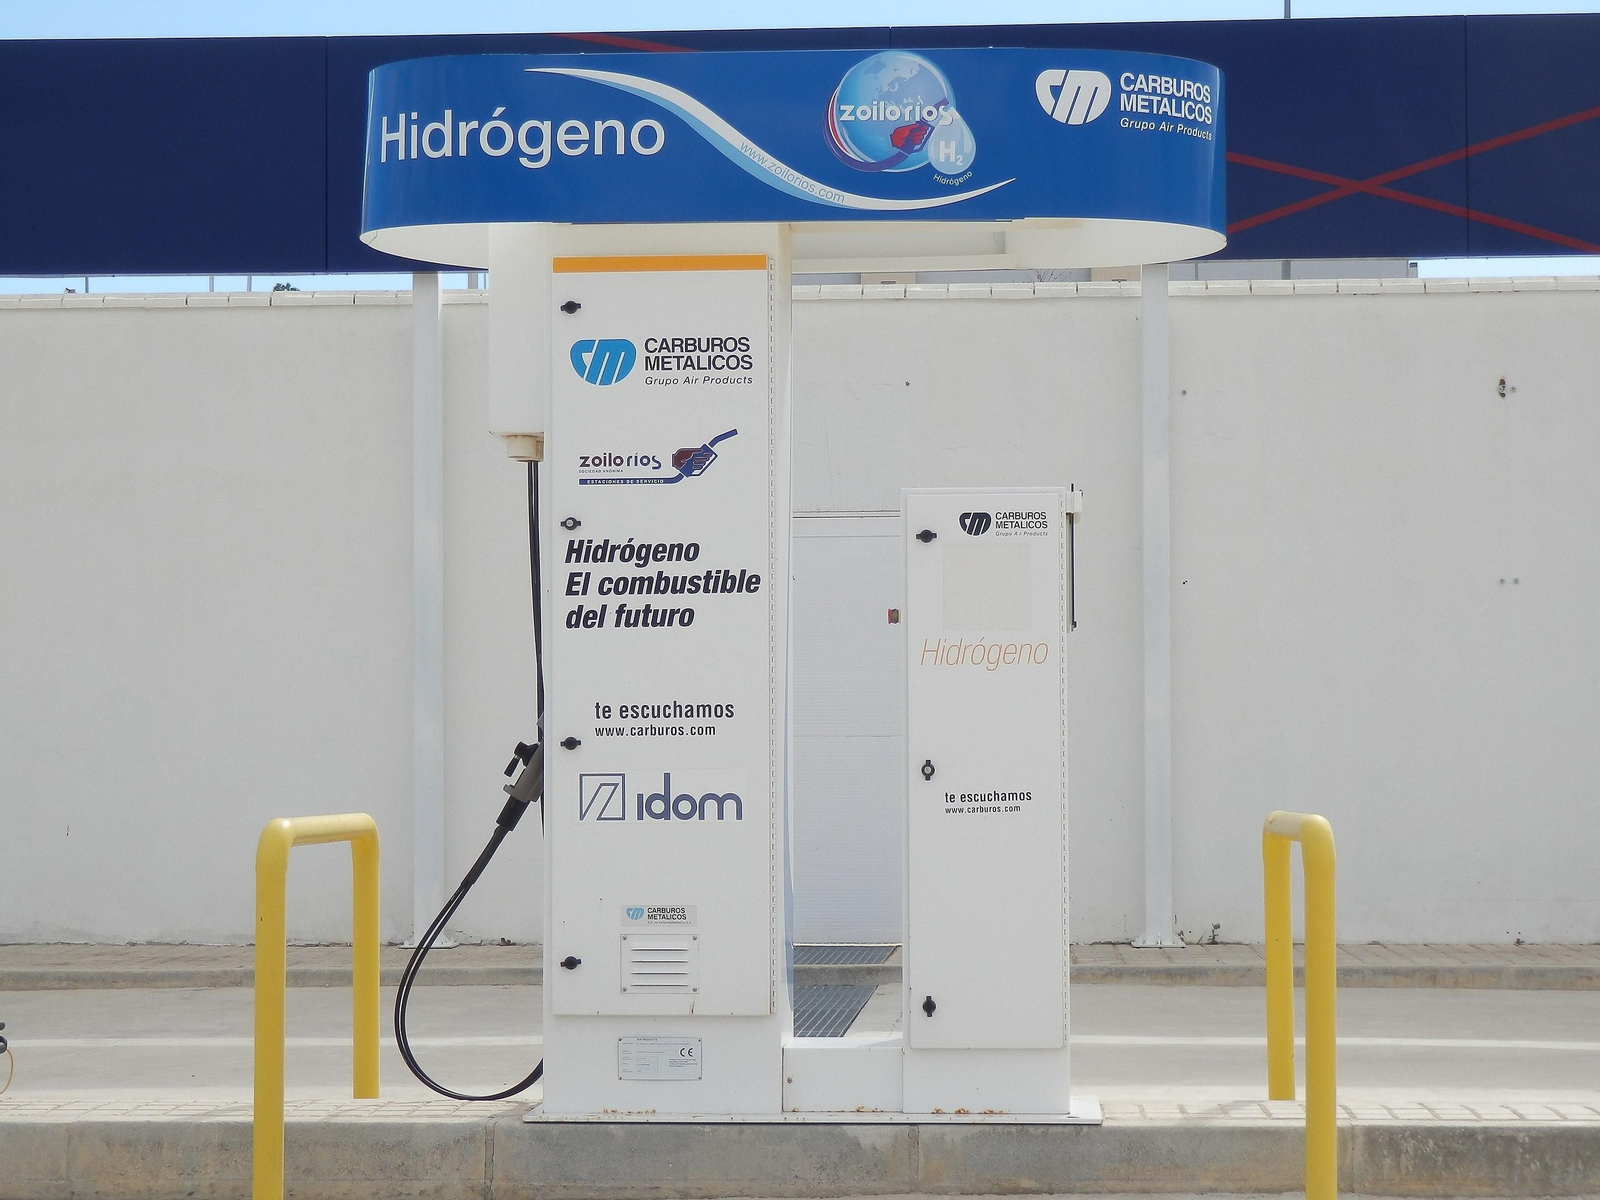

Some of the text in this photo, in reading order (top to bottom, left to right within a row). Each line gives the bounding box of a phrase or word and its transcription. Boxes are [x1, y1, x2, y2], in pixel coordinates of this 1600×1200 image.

[1120, 72, 1211, 104] CARBUROS
[1120, 93, 1212, 125] METALICOS
[380, 107, 665, 169] Hidrógeno
[1120, 117, 1213, 141] Grupo Air Products
[740, 142, 845, 204] www.zoilorios.com
[933, 170, 973, 186] Hidrógeno
[644, 336, 751, 354] CARBUROS
[644, 354, 754, 371] METALICOS
[644, 375, 753, 387] Grupo Air Products
[995, 511, 1047, 520] CARBUROS
[995, 520, 1049, 529] METALICOS
[565, 538, 700, 568] Hidrógeno
[565, 569, 761, 596] El combustible
[565, 603, 695, 629] del futuro
[920, 636, 1049, 672] Hidrógeno
[594, 701, 735, 719] te escuchamos
[594, 724, 717, 737] www.carburos.com
[637, 772, 743, 821] idom
[945, 790, 1032, 803] te escuchamos
[945, 804, 1021, 814] www.carburos.com
